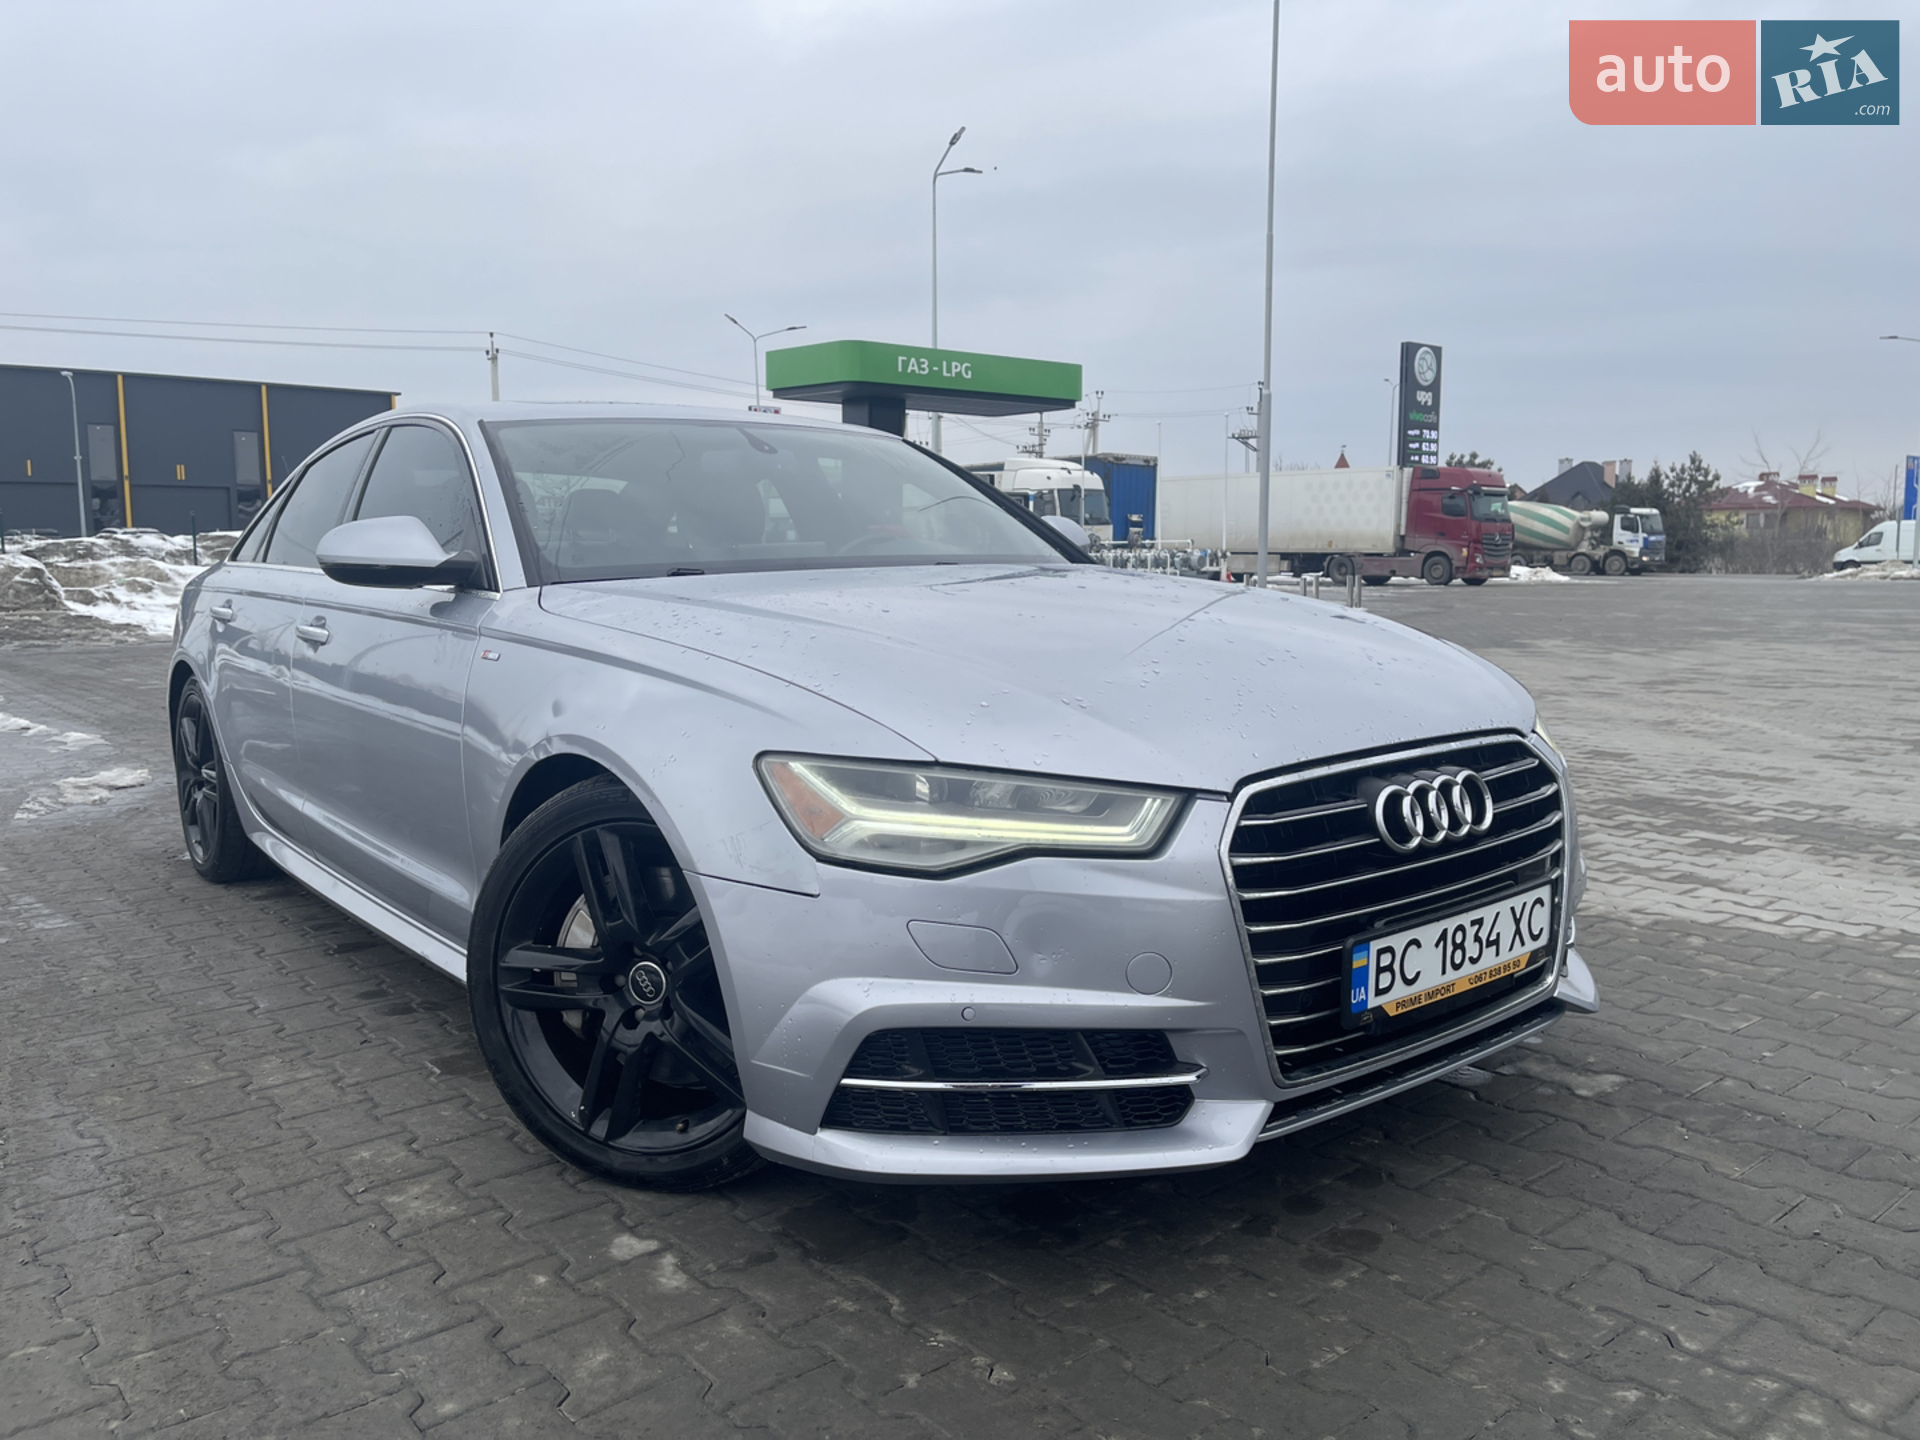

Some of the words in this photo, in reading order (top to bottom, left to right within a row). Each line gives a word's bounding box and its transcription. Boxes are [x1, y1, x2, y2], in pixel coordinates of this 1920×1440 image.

[898, 356, 929, 375] ГАЗ
[942, 360, 972, 379] LPG
[1416, 390, 1433, 406] upg
[1374, 937, 1422, 998] BC
[1434, 911, 1501, 976] 1834
[1508, 896, 1545, 952] XC
[1351, 986, 1366, 1004] UA
[1395, 994, 1422, 1012] PRIME
[1424, 983, 1456, 1002] IMPORT
